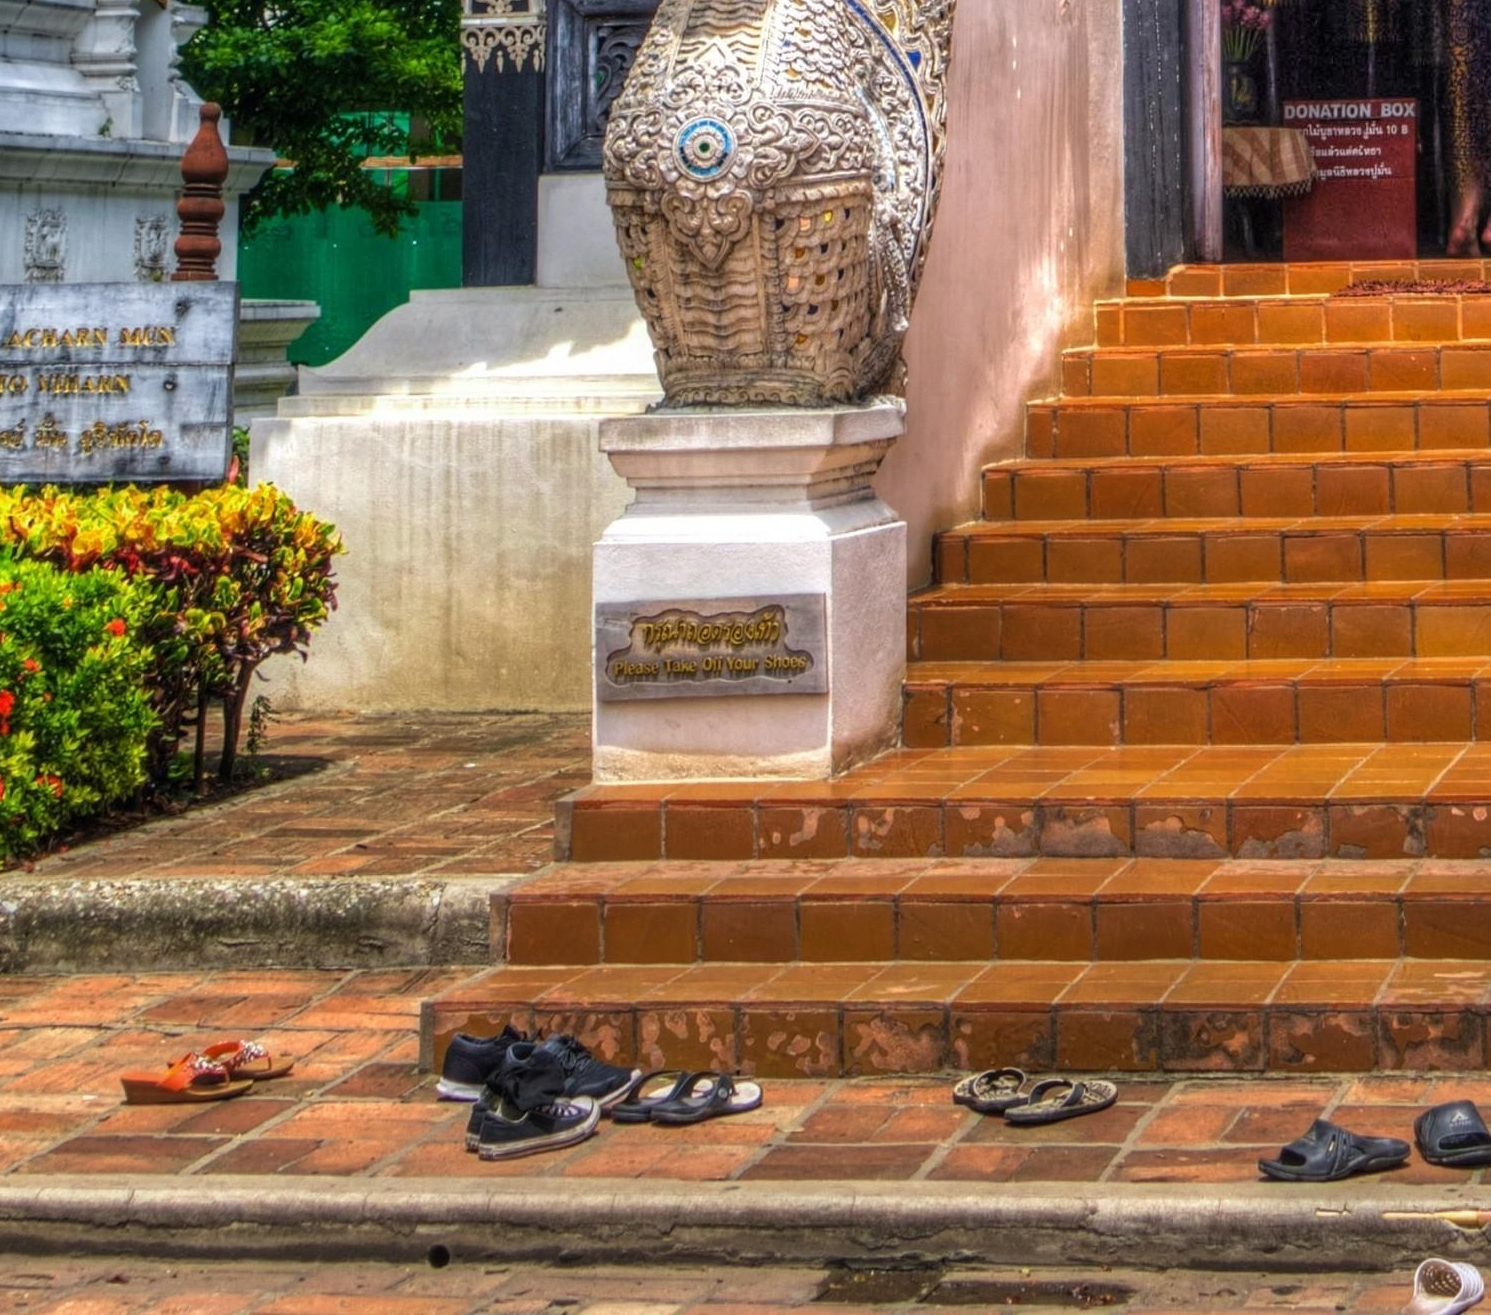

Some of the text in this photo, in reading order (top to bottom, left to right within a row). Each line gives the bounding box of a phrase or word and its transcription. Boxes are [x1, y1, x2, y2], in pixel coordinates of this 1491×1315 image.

[1284, 102, 1415, 119] DONATION BOX
[1386, 124, 1397, 135] 10
[4, 327, 109, 349] ACHARN
[118, 325, 176, 347] MUN
[36, 373, 132, 394] VIHARN
[642, 611, 781, 650] กรุณาถอดรองเท้า
[614, 655, 807, 676] Please Take Off Your Shoes
